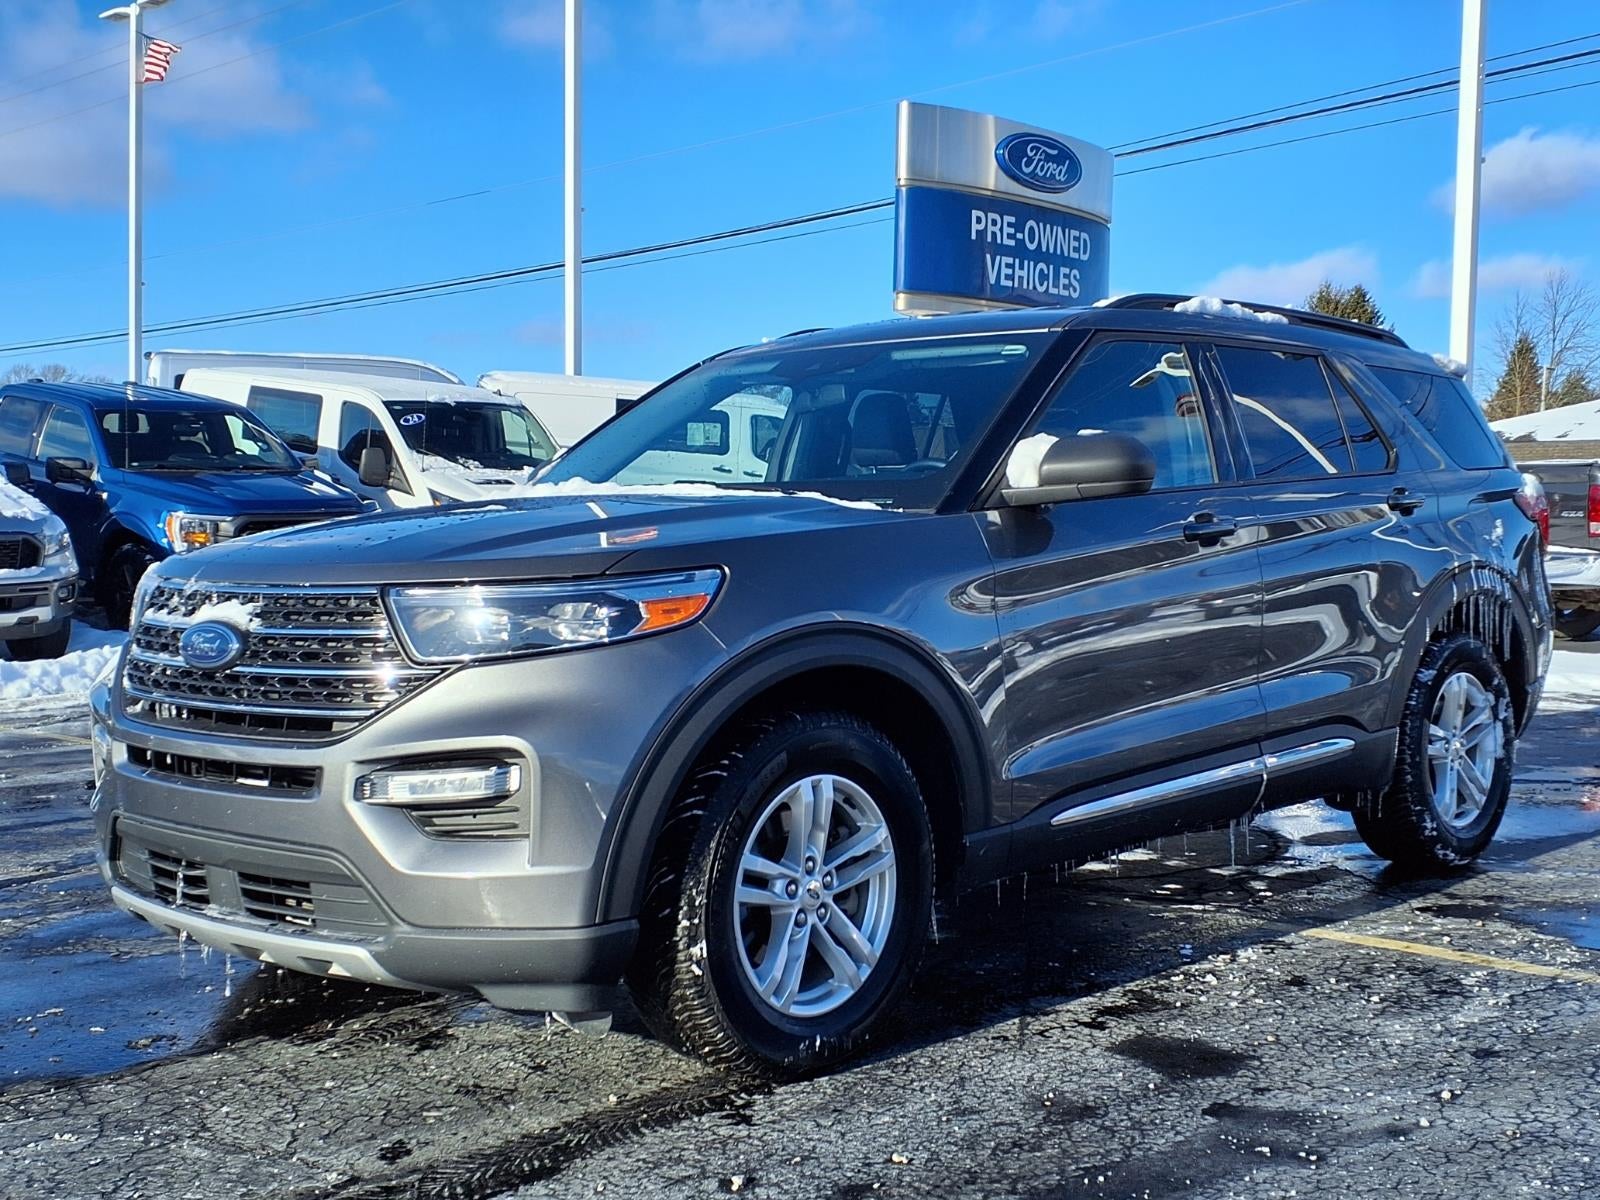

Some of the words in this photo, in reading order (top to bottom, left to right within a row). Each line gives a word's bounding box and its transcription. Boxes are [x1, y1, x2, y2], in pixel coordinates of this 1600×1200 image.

[1021, 143, 1070, 182] Ford
[970, 209, 1091, 261] PRE-OWNED
[985, 253, 1081, 298] VEHICLES
